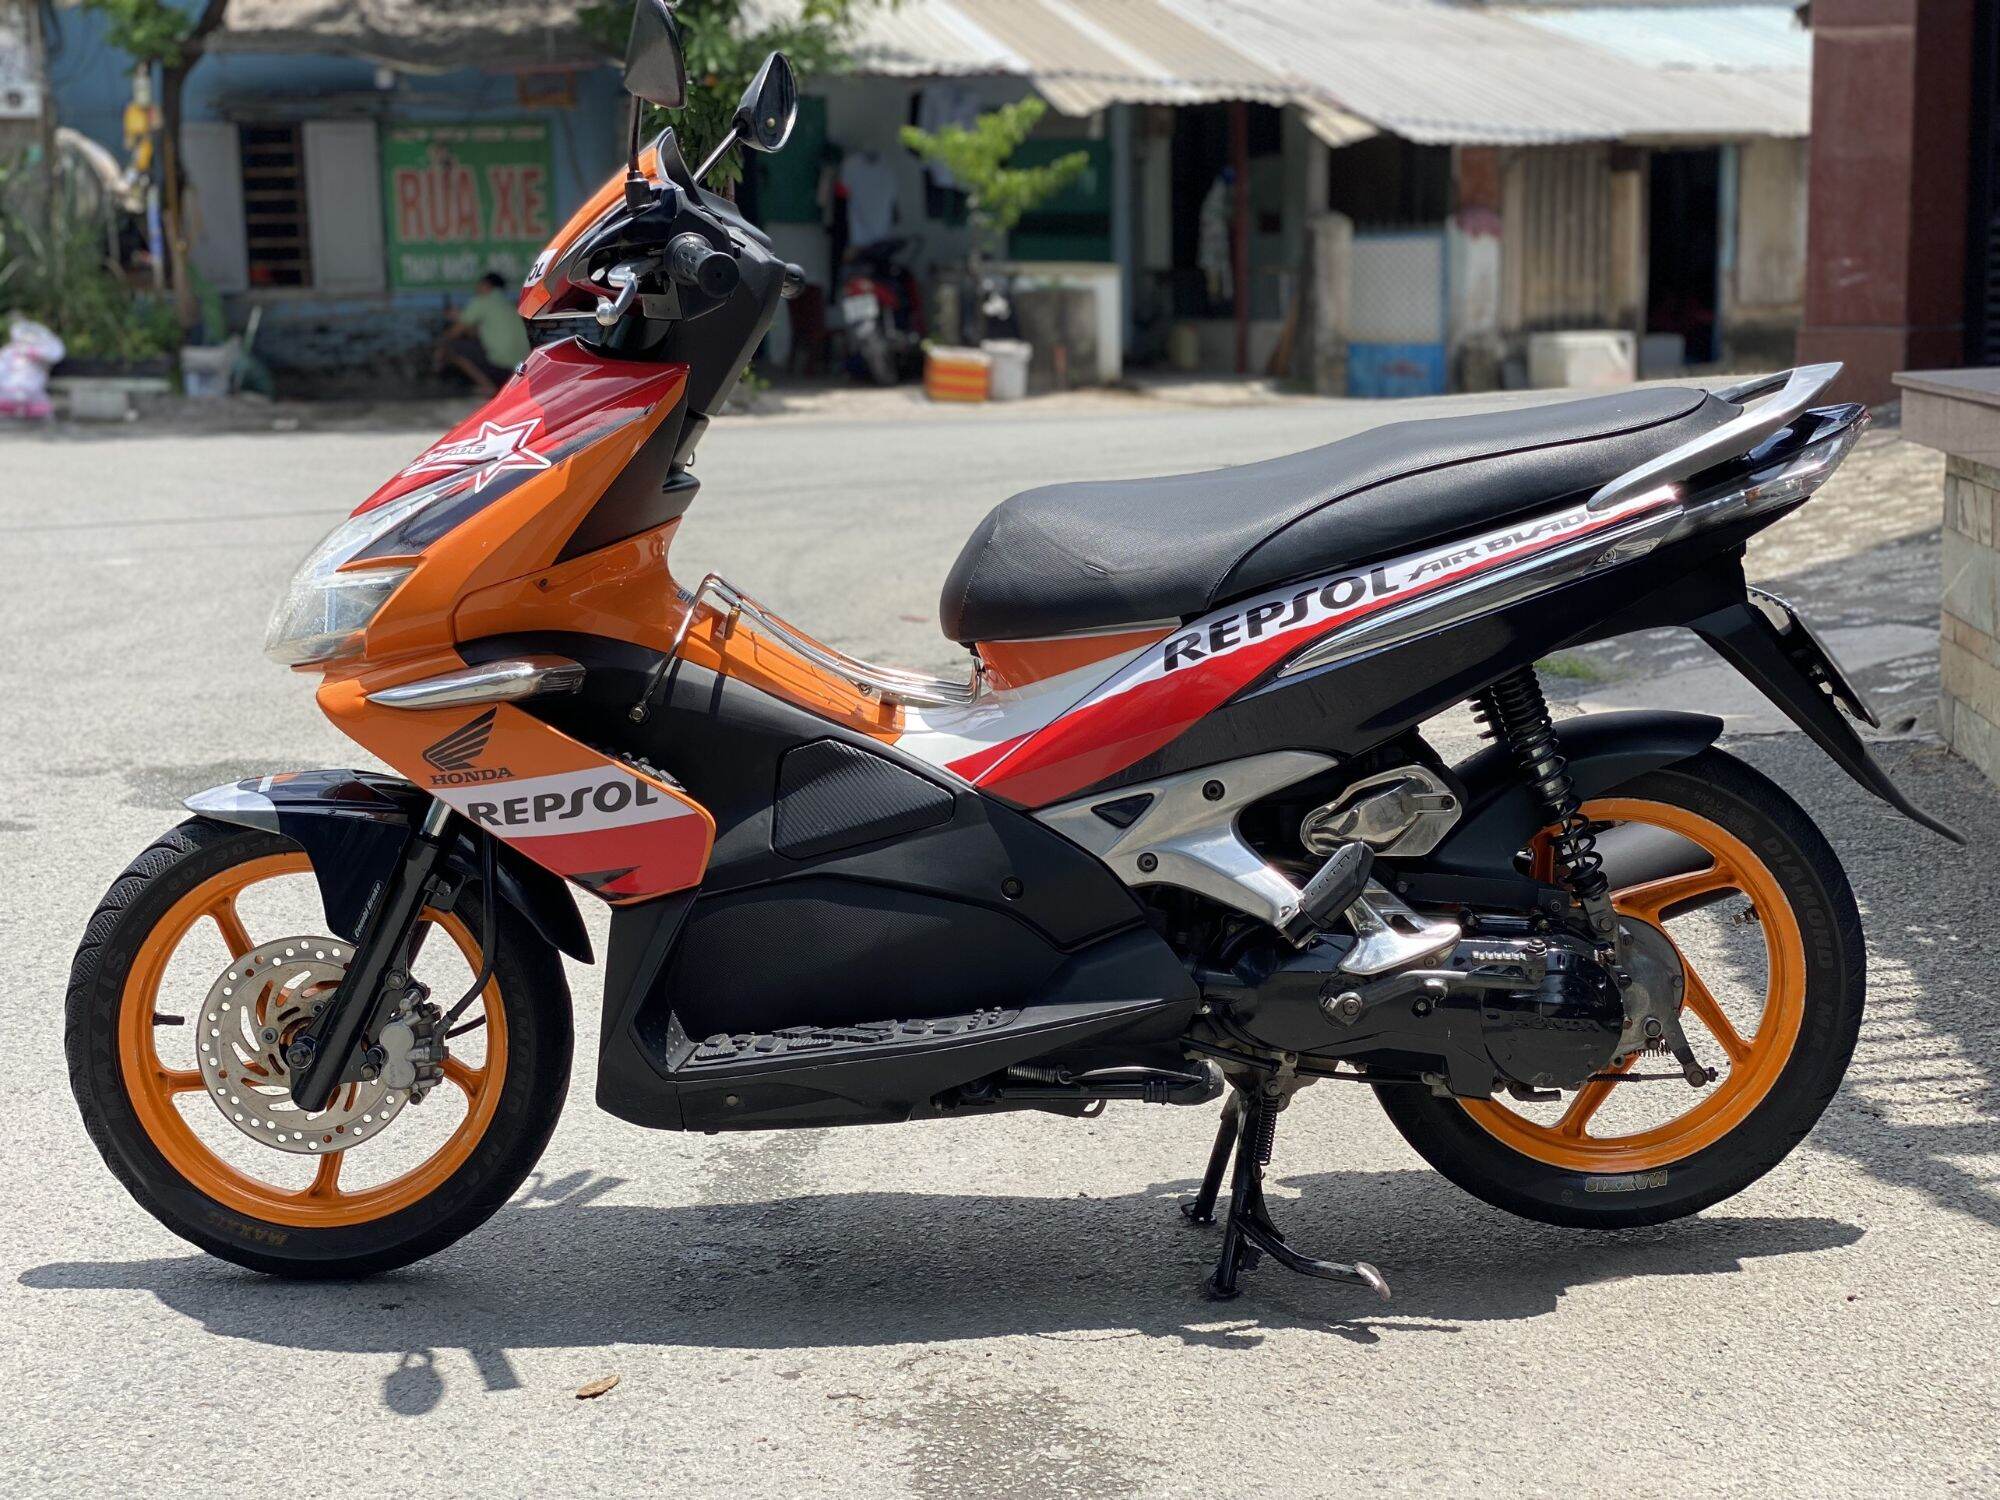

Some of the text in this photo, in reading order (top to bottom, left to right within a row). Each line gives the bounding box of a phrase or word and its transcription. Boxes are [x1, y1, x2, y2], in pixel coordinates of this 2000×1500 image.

[394, 145, 548, 243] RỬA XE
[1164, 567, 1400, 671] REPSOL
[1405, 547, 1481, 581] AIR
[430, 767, 515, 785] HONDA
[467, 777, 659, 826] REPSOL
[1761, 836, 1834, 968] DIAMOND
[1585, 1169, 1668, 1193] MAXXIS
